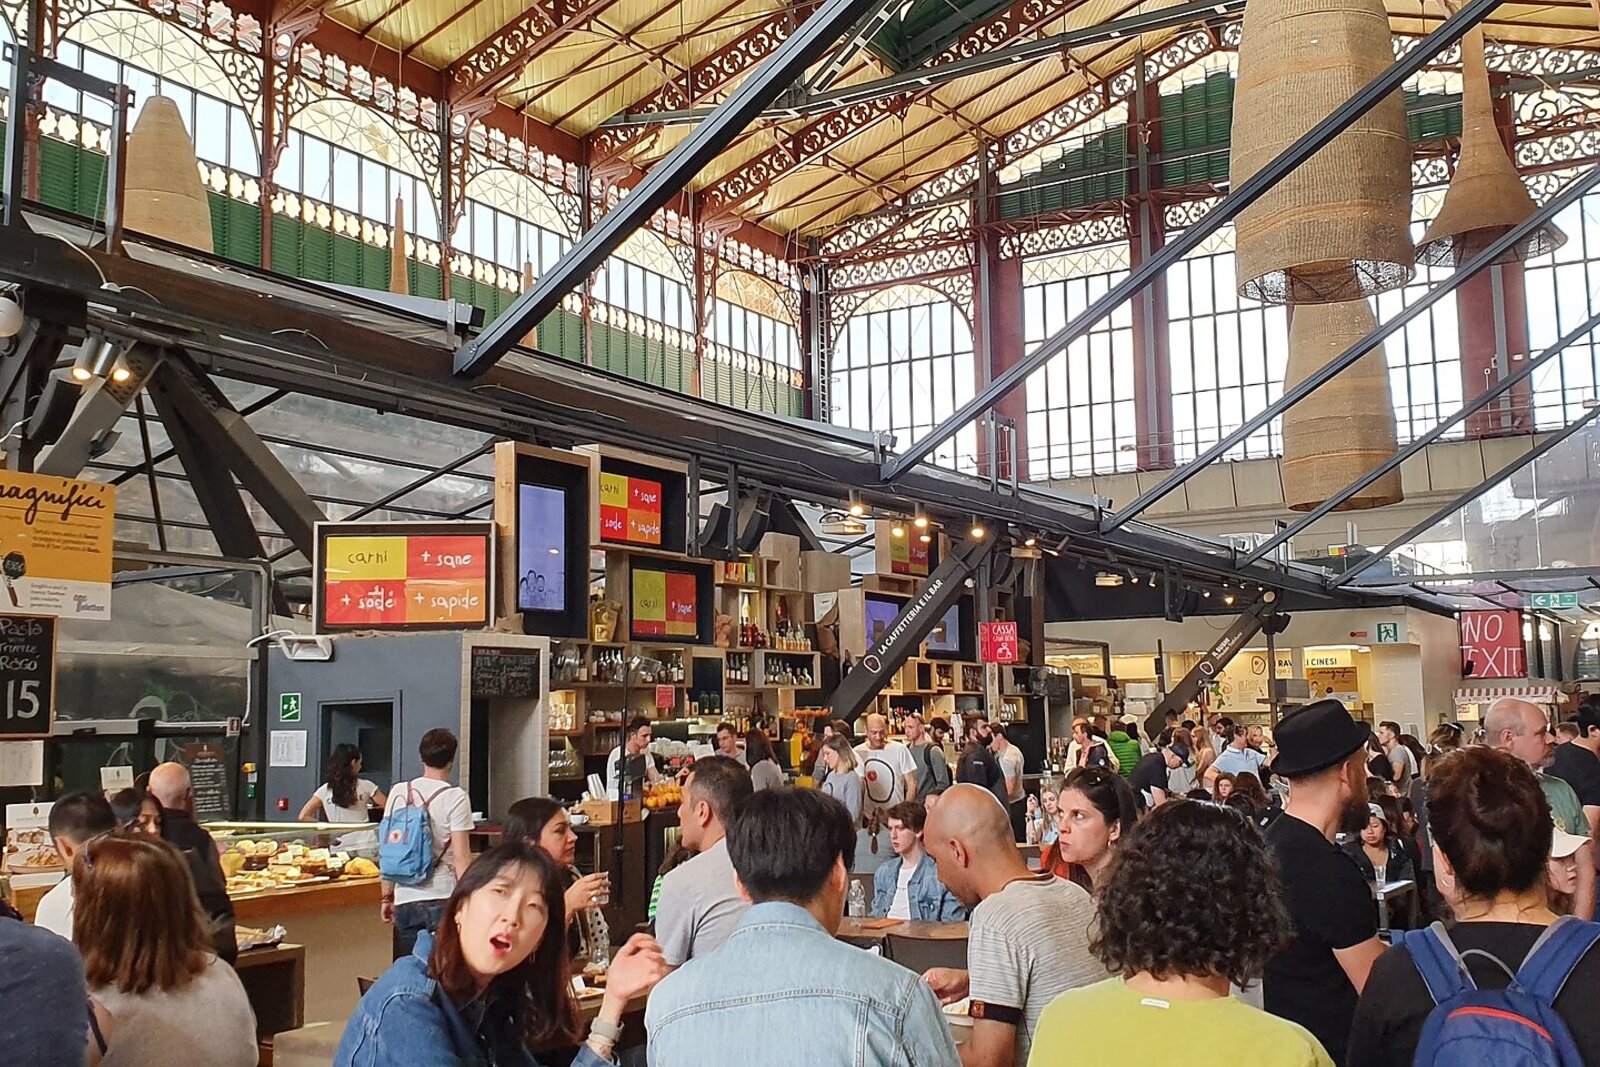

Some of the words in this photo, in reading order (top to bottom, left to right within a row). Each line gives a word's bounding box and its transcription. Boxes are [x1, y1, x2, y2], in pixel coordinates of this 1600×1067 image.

[348, 551, 388, 564] carni
[436, 553, 472, 568] sane
[430, 589, 479, 617] sapide
[878, 644, 888, 655] LA
[885, 604, 923, 646] CAFFETTERIA
[922, 593, 932, 602] IL
[928, 579, 943, 595] BAR
[993, 624, 1014, 635] CASSA
[1465, 614, 1502, 643] NO
[1311, 658, 1337, 666] CINESI
[1464, 646, 1524, 677] EXIT
[7, 680, 40, 719] 15
